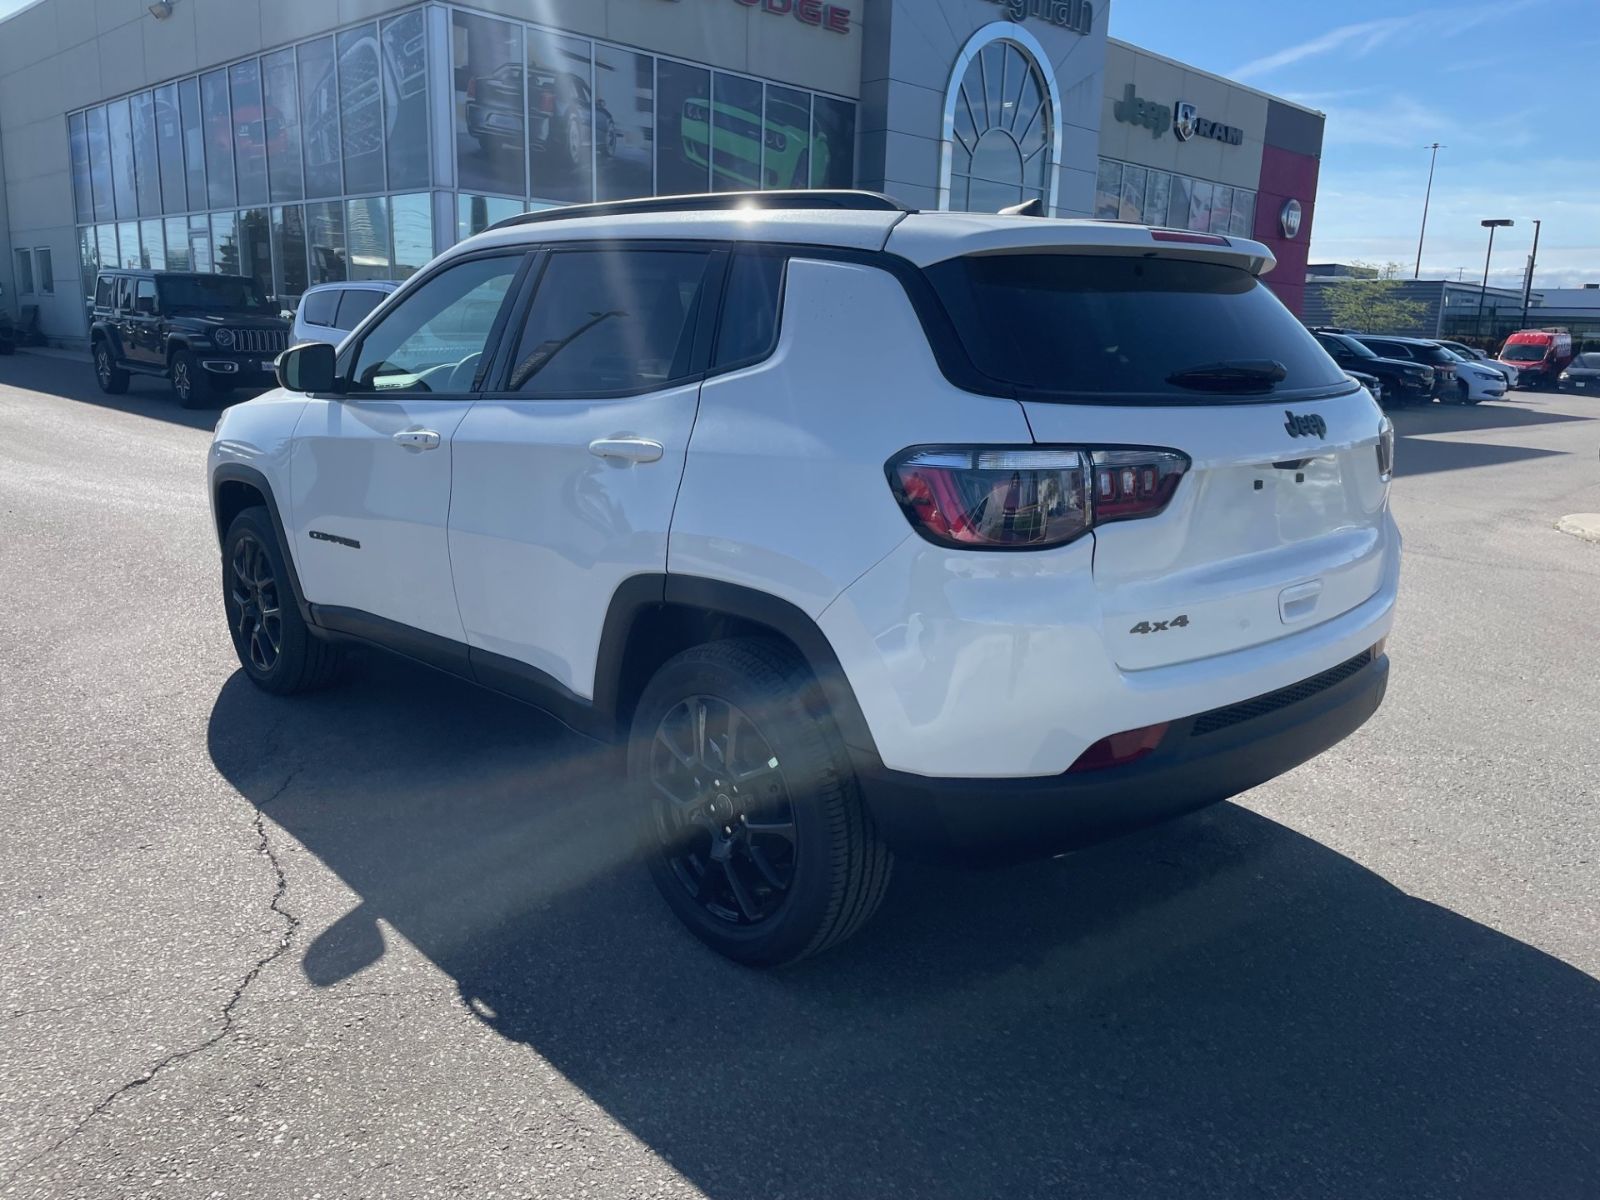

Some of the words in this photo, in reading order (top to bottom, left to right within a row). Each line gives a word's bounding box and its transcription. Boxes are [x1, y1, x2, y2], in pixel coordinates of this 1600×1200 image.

[734, 0, 851, 35] DGE
[1195, 117, 1243, 146] RAM
[1283, 410, 1327, 440] Jeep
[1129, 614, 1190, 635] 4x4
